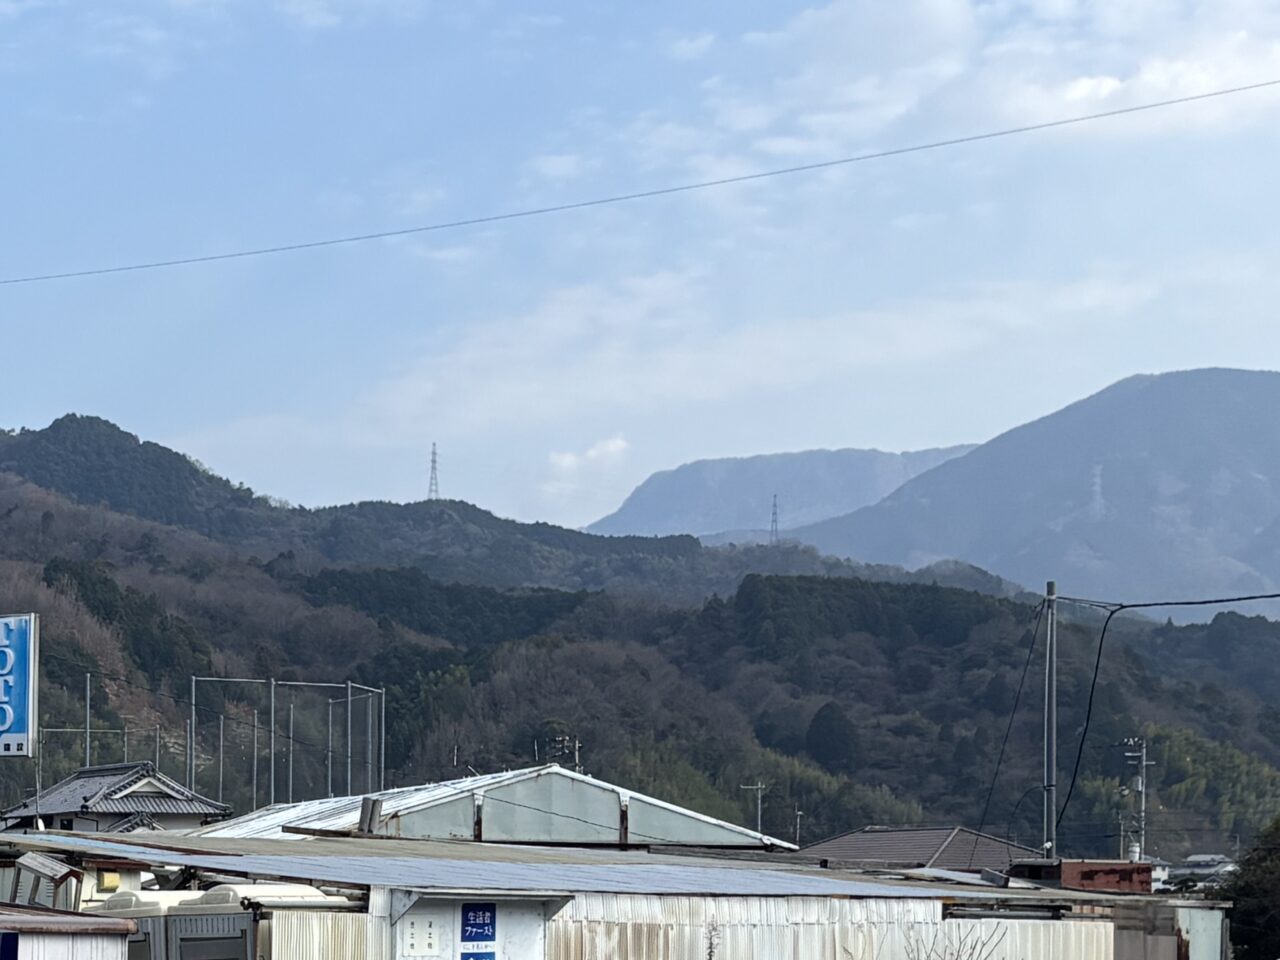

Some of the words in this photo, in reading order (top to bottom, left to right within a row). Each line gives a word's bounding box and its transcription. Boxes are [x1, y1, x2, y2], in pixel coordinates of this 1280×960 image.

[465, 926, 493, 937] ファースト
